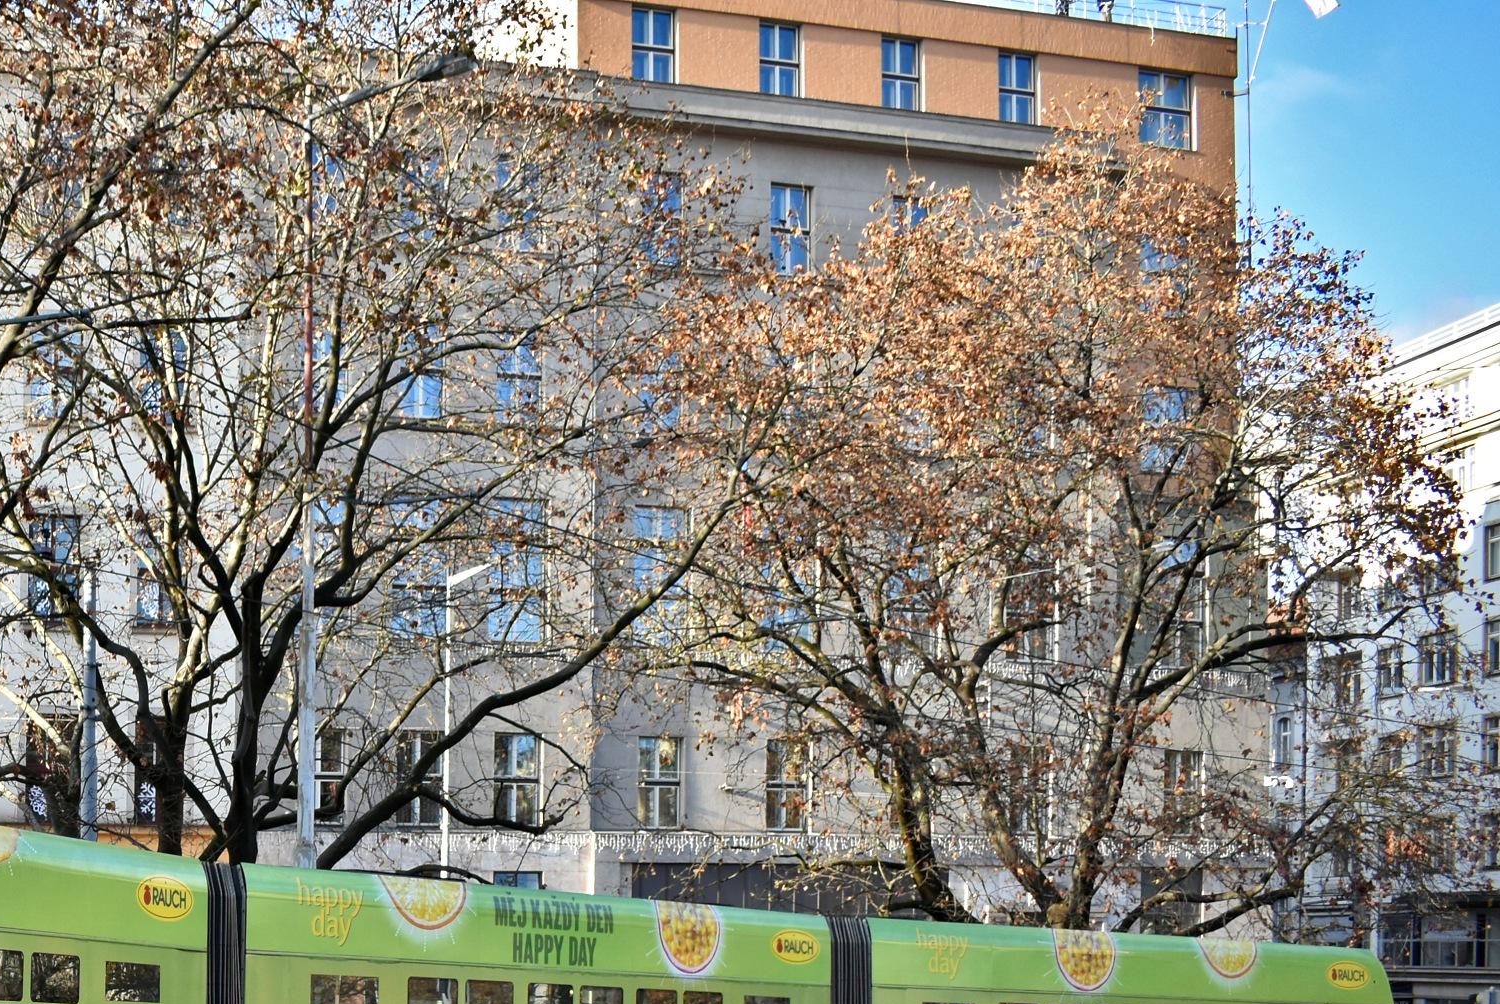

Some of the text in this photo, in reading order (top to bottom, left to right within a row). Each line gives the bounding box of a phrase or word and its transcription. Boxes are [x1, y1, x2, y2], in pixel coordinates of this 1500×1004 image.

[152, 890, 187, 910] RAUCH
[296, 876, 365, 921] happy
[493, 891, 614, 935] MĚJ KAŽDÝ DEN
[311, 908, 353, 947] day
[915, 926, 969, 960] happy
[512, 932, 597, 967] HAPPY DAY
[784, 938, 814, 956] RAUCH
[928, 950, 960, 981] day
[1338, 968, 1366, 983] RAUCH
